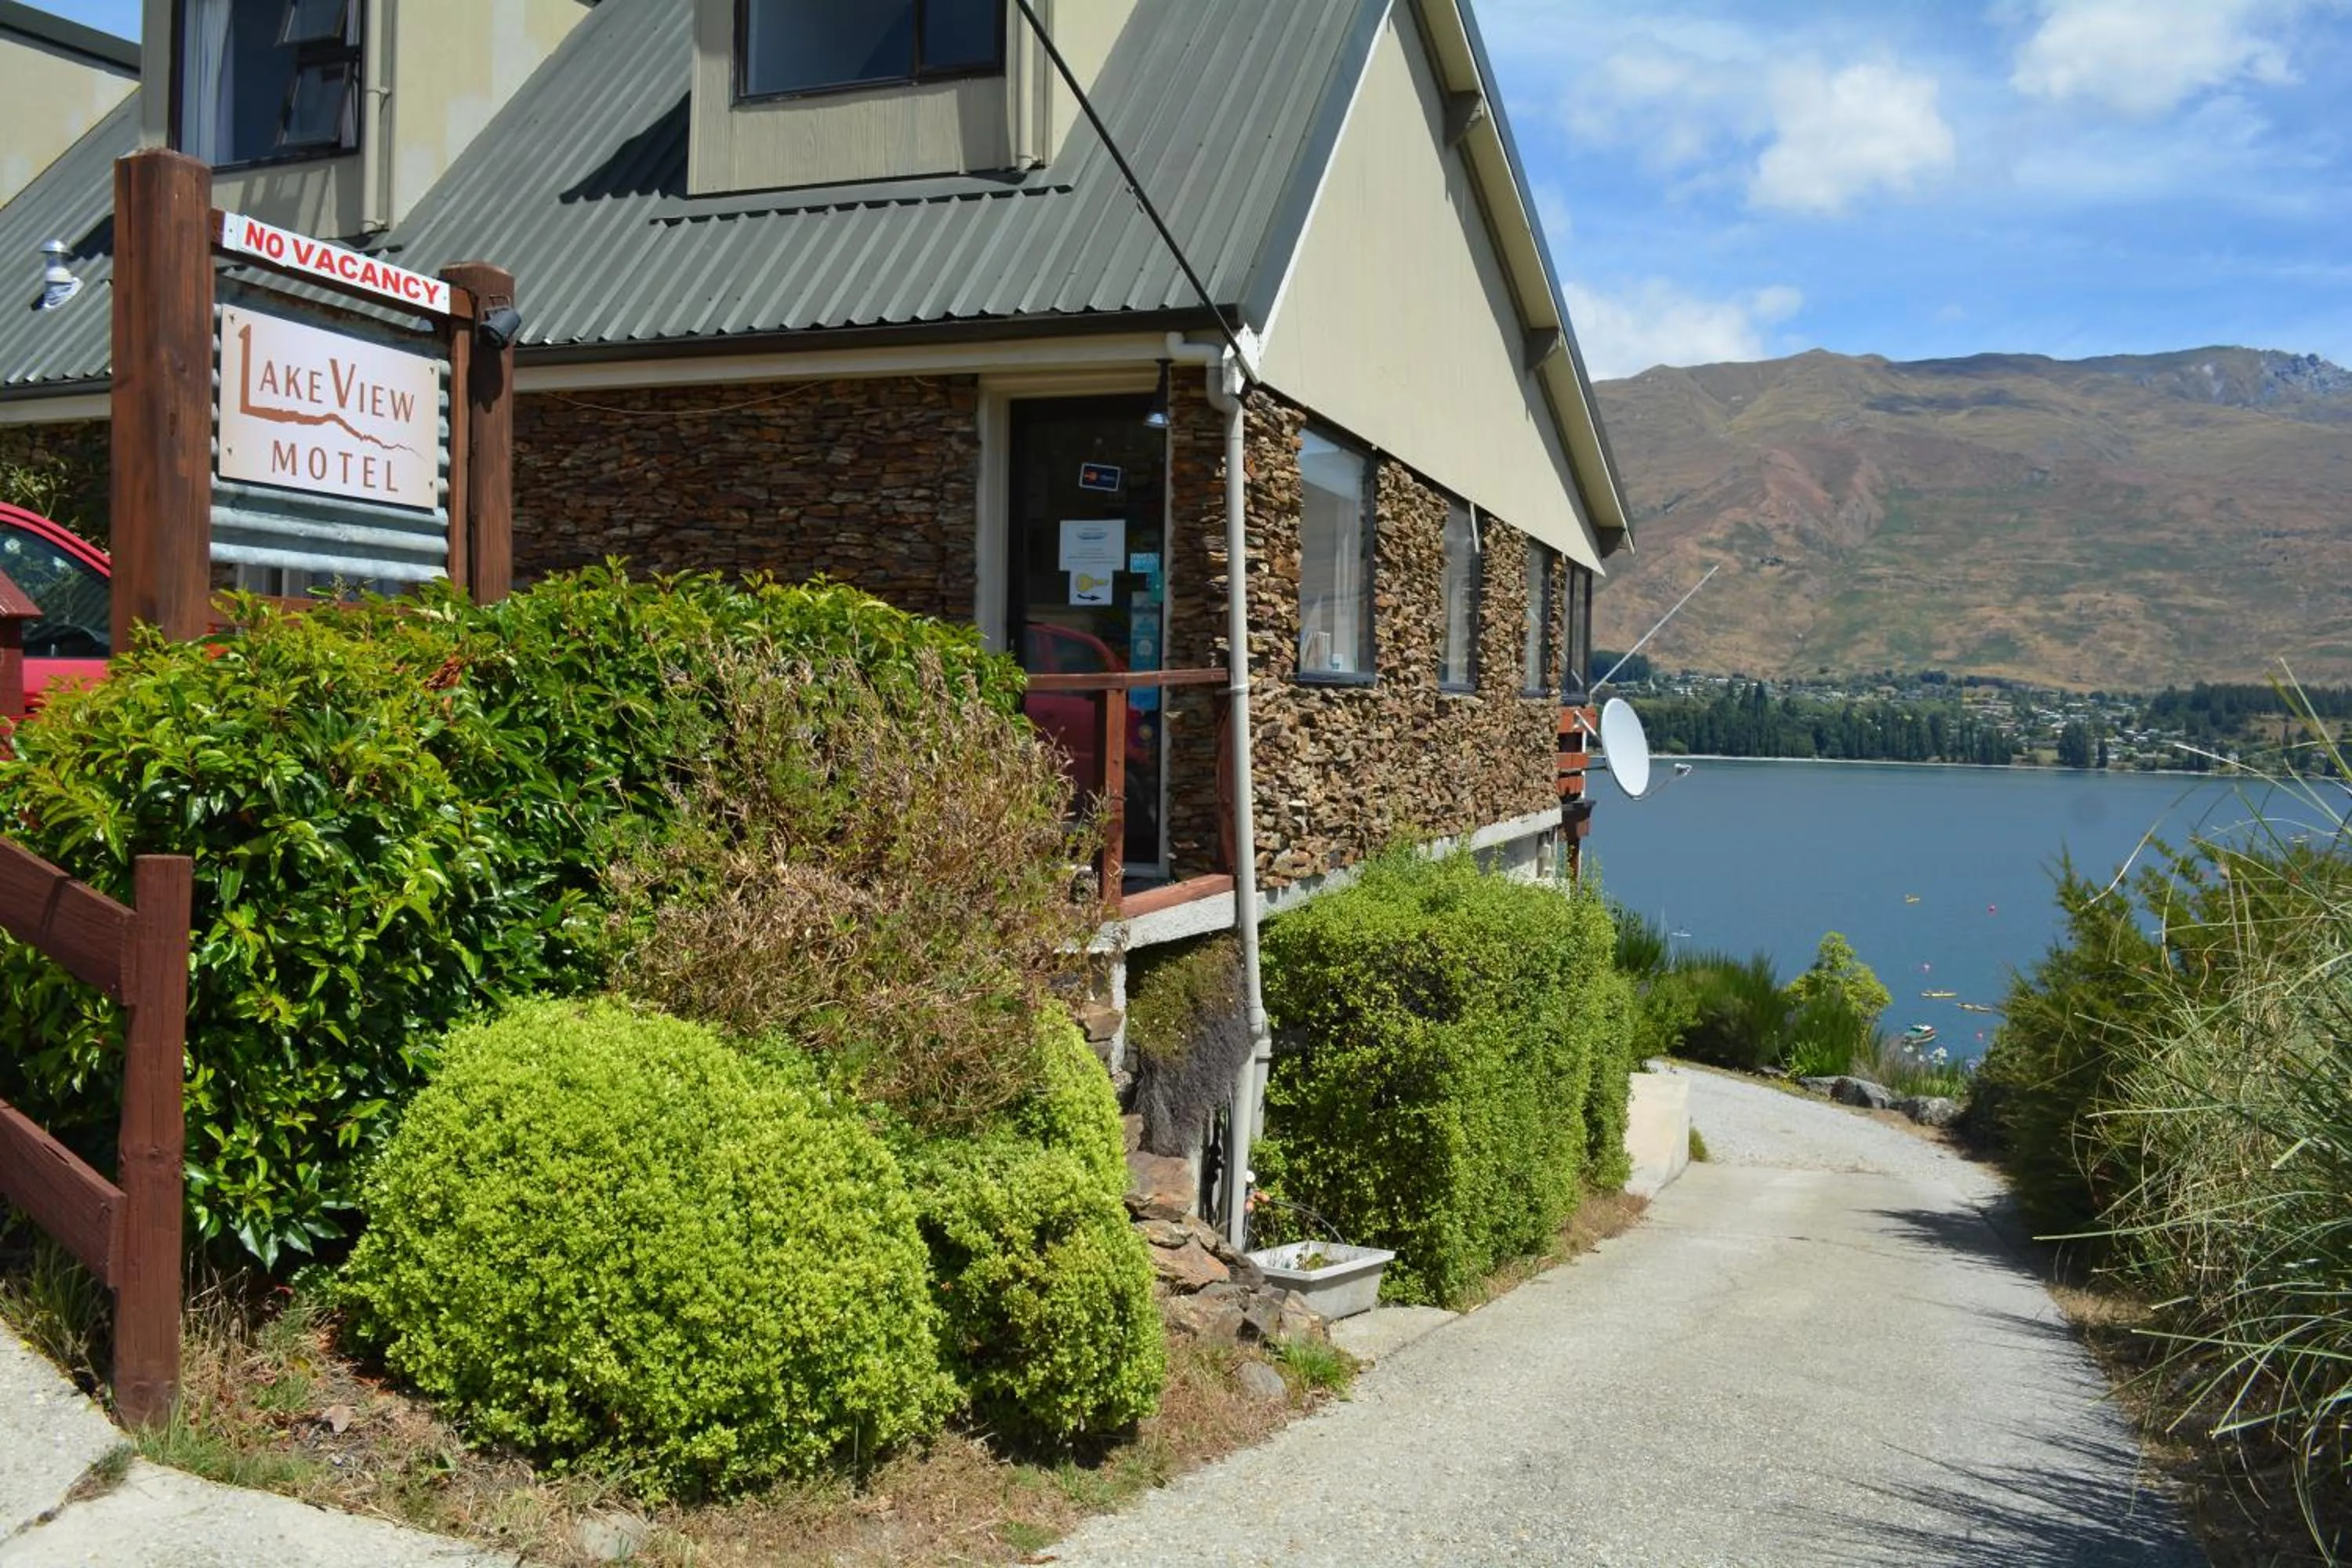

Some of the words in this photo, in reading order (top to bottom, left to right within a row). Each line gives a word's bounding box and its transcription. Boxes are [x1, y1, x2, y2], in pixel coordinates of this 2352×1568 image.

[245, 220, 285, 260] NO
[292, 238, 440, 305] VACANCY
[271, 439, 399, 492] MOTEL
